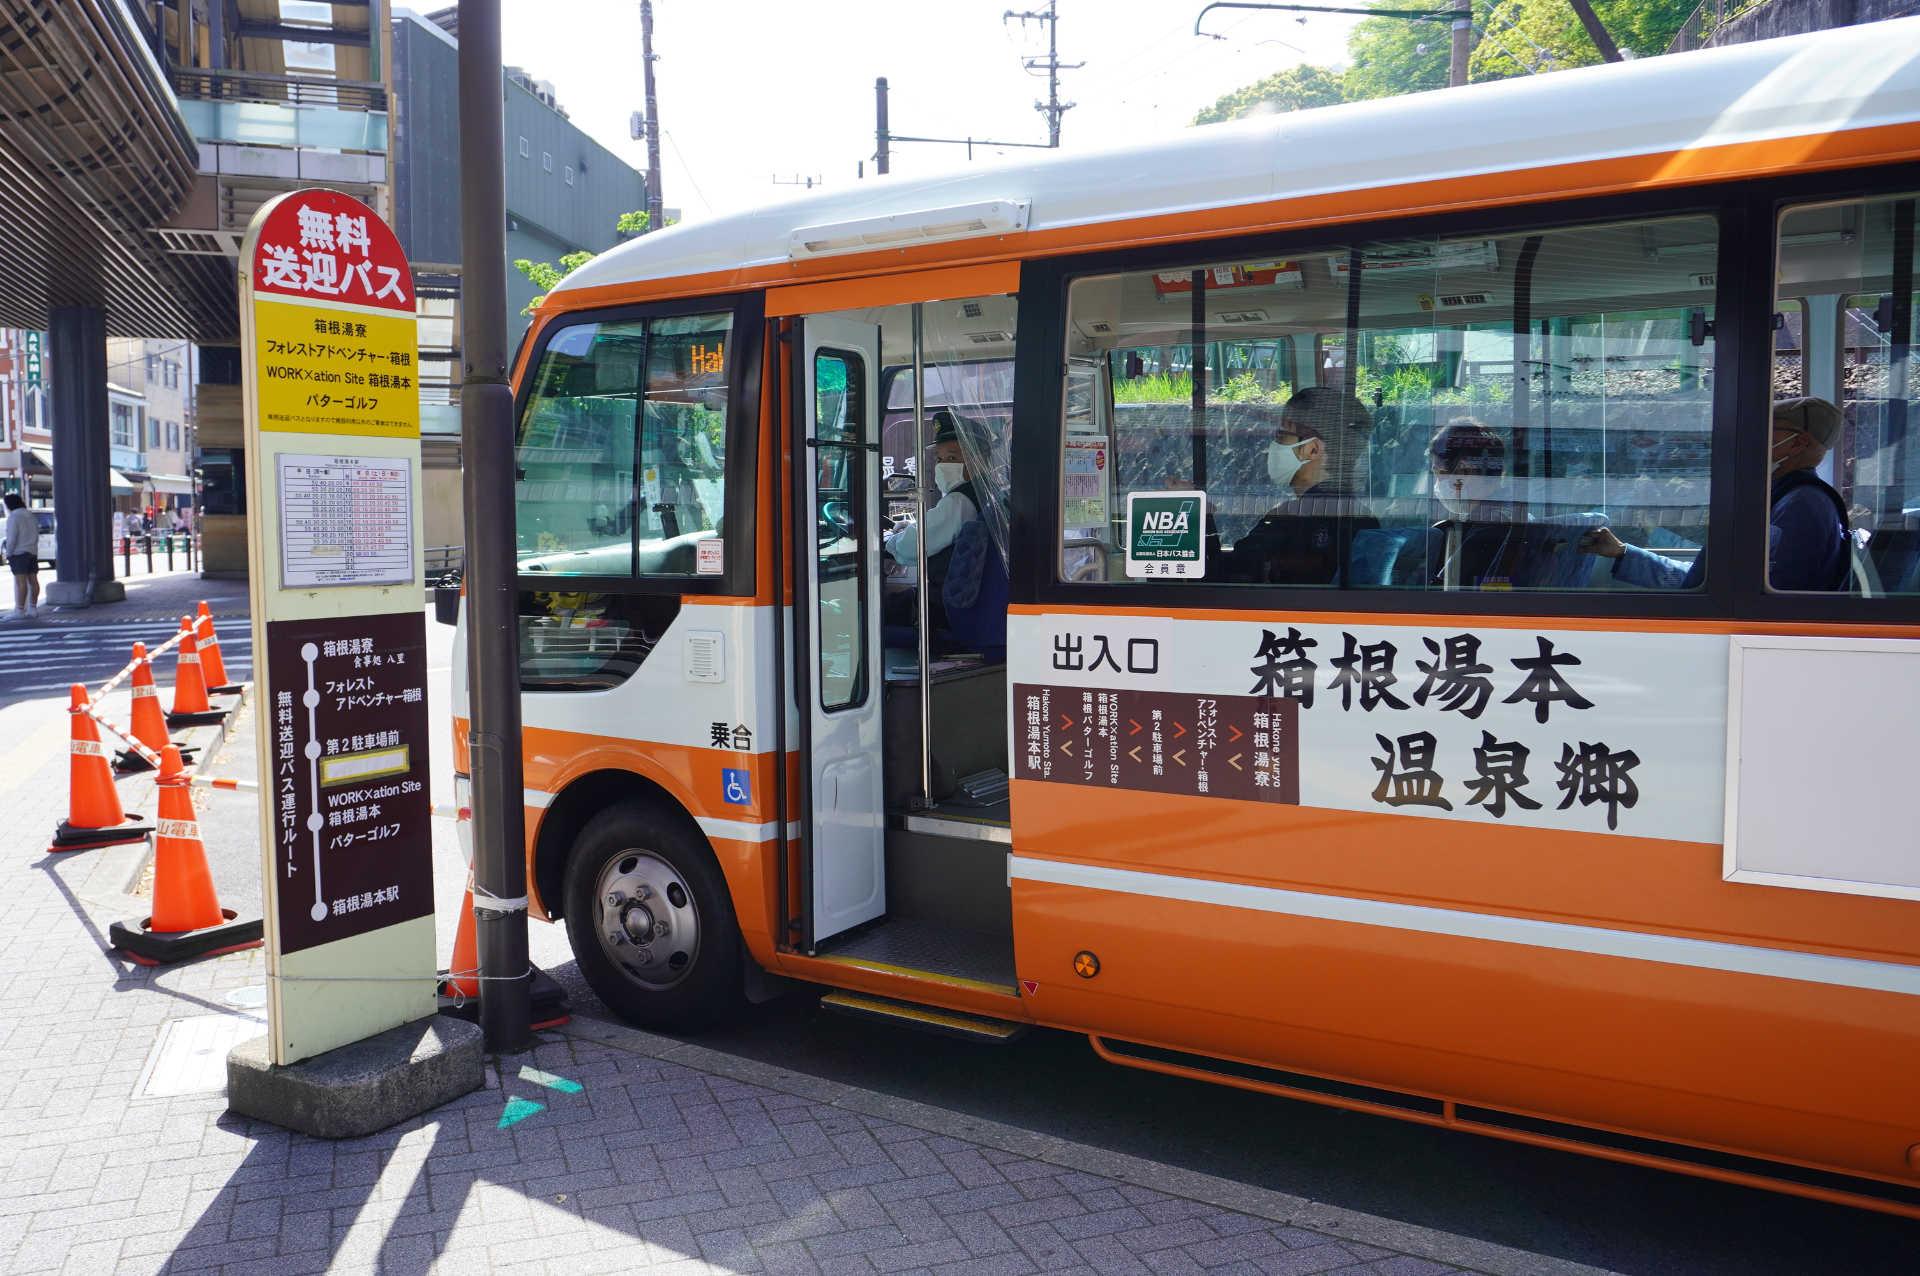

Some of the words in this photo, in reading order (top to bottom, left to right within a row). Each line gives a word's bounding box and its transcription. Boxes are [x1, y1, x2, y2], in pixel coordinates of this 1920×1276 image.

[297, 204, 371, 257] 無料
[262, 242, 406, 303] 送迎バス
[314, 319, 367, 338] 箱根湯寮
[29, 333, 39, 381] AKAMI
[266, 340, 411, 366] フォレストアドベンチャー・箱根
[344, 372, 365, 386] Site
[368, 373, 411, 390] 箱根湯本
[306, 394, 378, 410] パターゴルフ
[1142, 511, 1189, 530] NBA
[1145, 563, 1186, 574] 会員章
[323, 638, 373, 657] 箱根湯寮
[354, 655, 382, 668] 食事処
[387, 653, 405, 665] 八里
[1053, 633, 1159, 674] 出入口
[326, 676, 375, 694] フォレスト
[1248, 626, 1596, 724] 箱根湯本
[132, 687, 157, 697] 登山
[336, 688, 422, 711] アドベンチャー箱根
[1042, 689, 1051, 722] Hakone
[1097, 692, 1109, 738] 箱根湯本
[1207, 699, 1217, 749] フォレスト
[326, 730, 400, 755] 第2駐車場前
[711, 722, 752, 751] 乗合
[1027, 695, 1042, 771] 箱根湯本駅
[1043, 725, 1051, 759] Yumoto
[1151, 709, 1163, 776] 第2駐車場前
[1197, 698, 1209, 793] アドベンチャー・箱根
[1272, 713, 1282, 753] Hakone
[1253, 712, 1270, 787] 箱根湯寮
[1044, 760, 1052, 779] Sta.
[1110, 764, 1119, 785] Site
[1272, 754, 1281, 788] yuryo
[1370, 729, 1641, 831] 温泉郷
[278, 691, 297, 878] 無料送迎バス運行ルート
[402, 781, 421, 794] Site
[158, 822, 199, 837] 山電車
[329, 804, 381, 827] 箱根湯本
[330, 823, 401, 850] パターゴルフ
[333, 885, 400, 916] 箱根湯本駅
